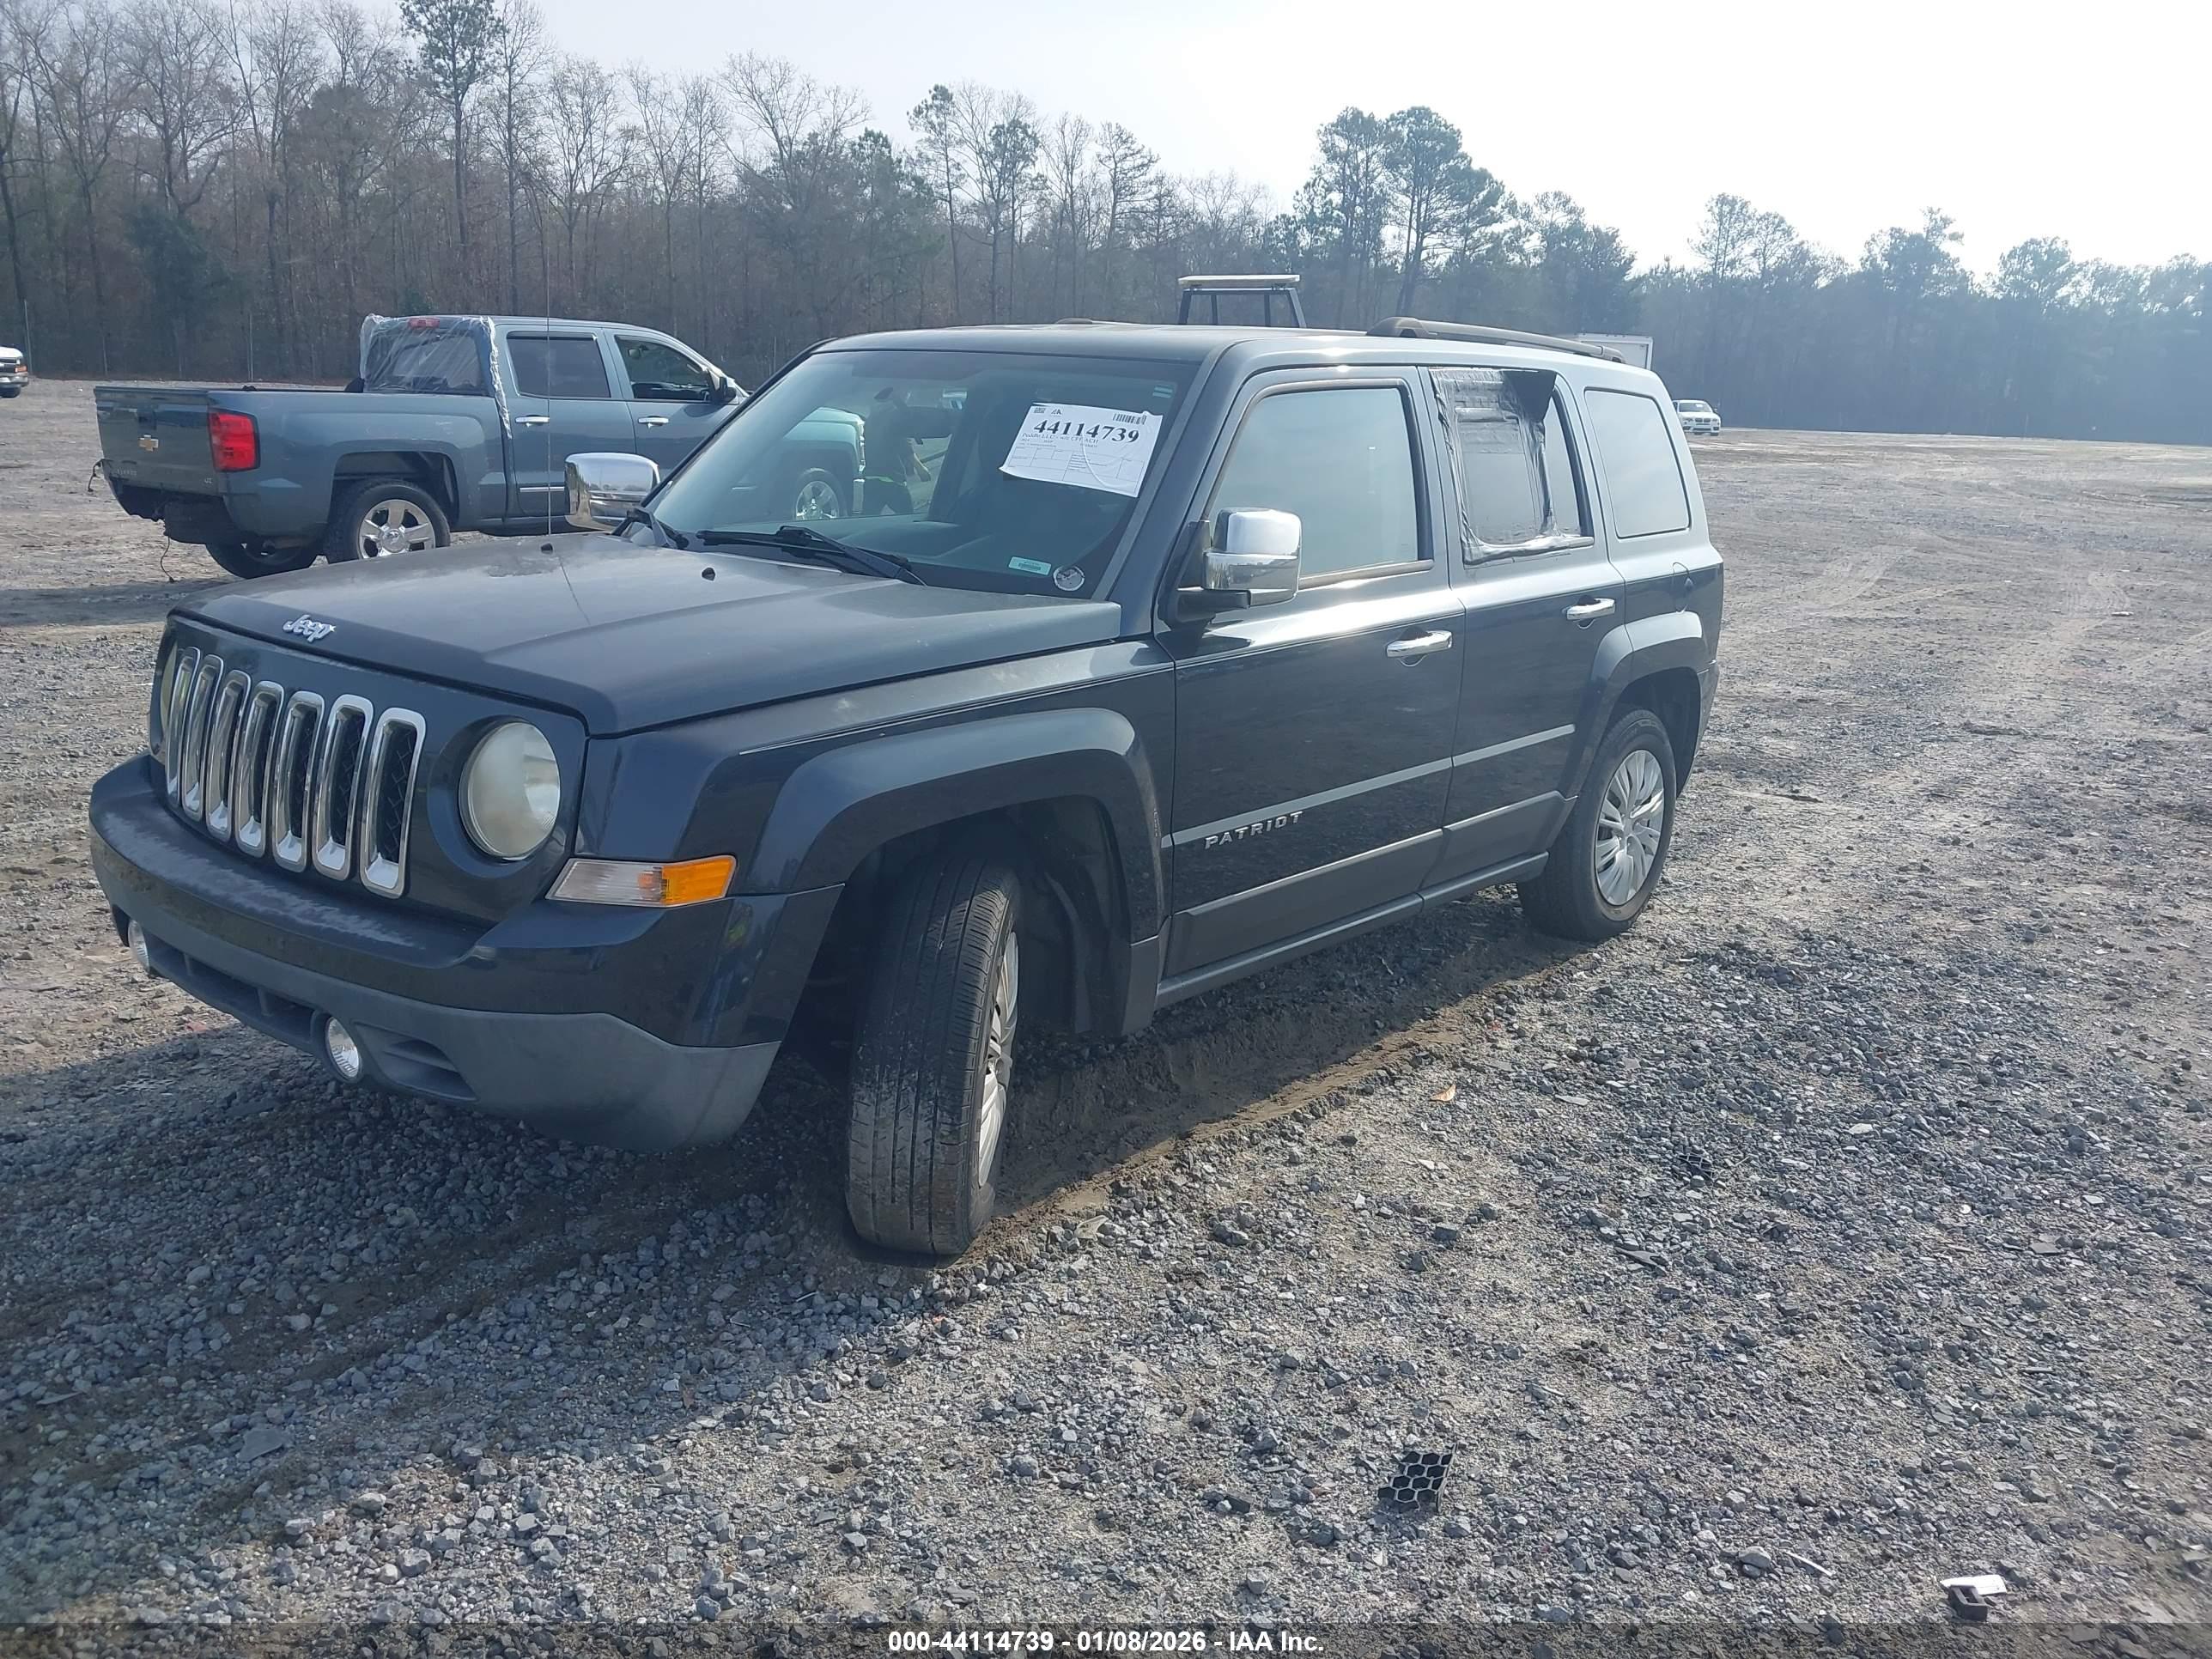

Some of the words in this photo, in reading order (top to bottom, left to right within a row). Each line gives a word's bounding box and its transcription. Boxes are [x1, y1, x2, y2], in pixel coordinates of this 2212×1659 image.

[1033, 419, 1139, 443] 44114739
[283, 614, 333, 642] Jeep
[1205, 811, 1304, 849] PATRIOT
